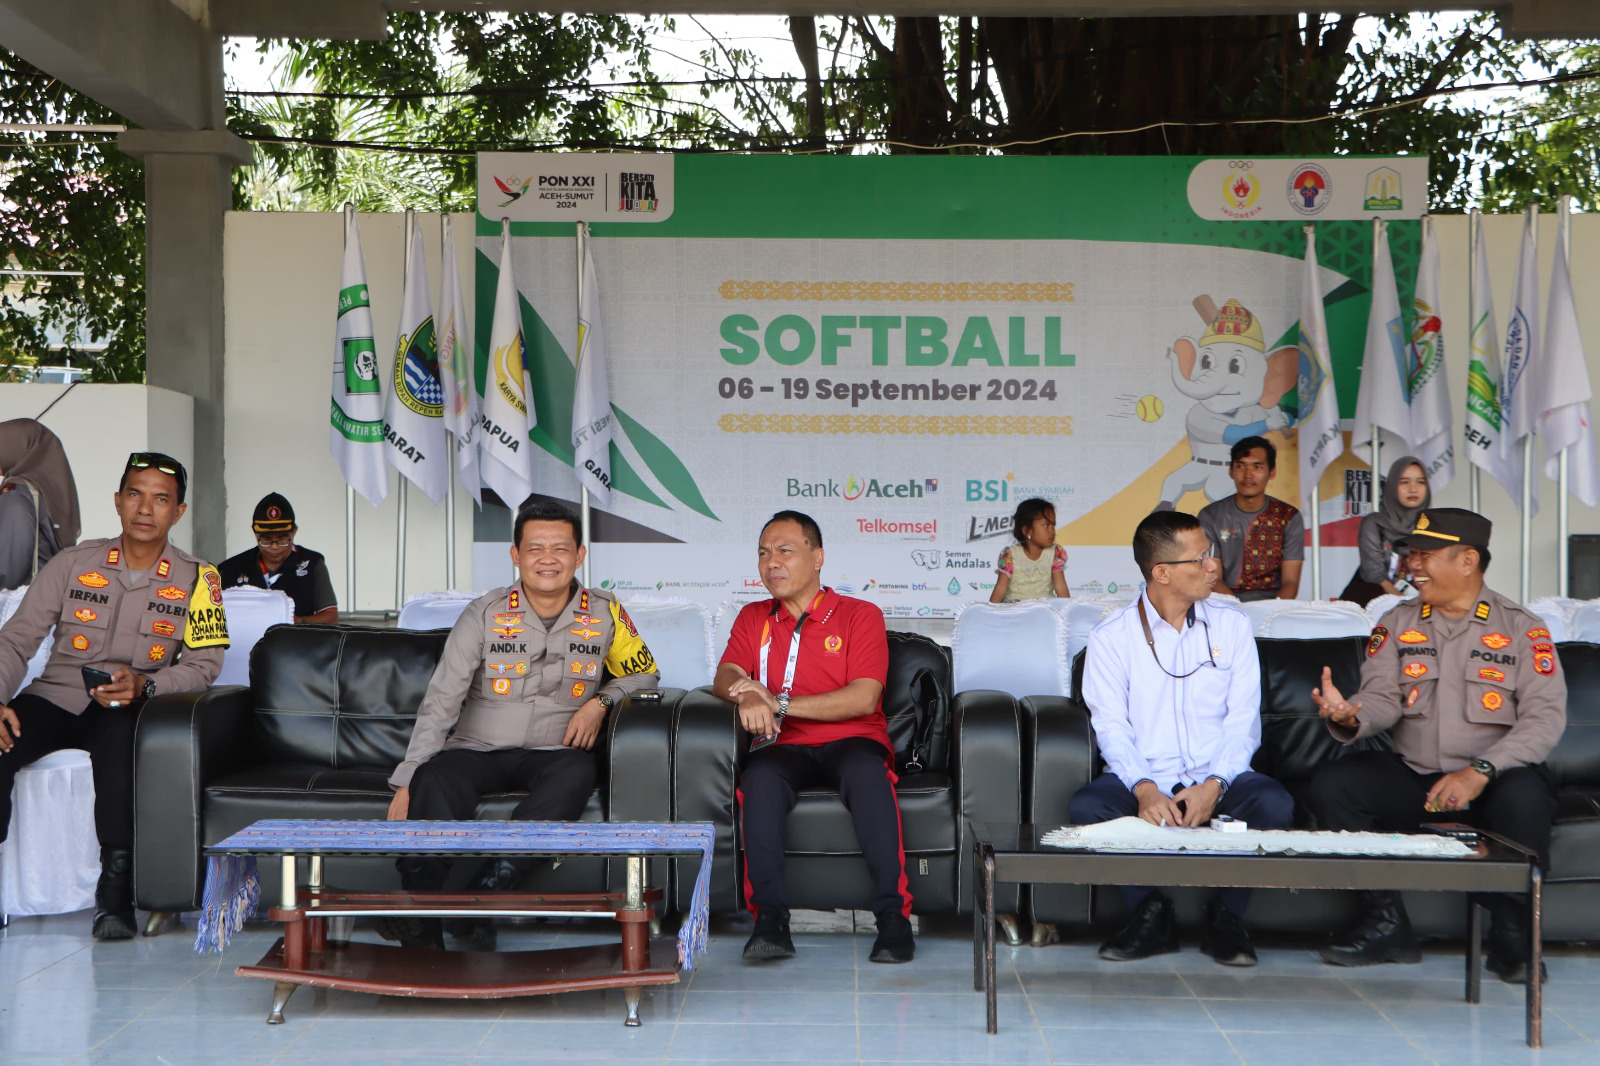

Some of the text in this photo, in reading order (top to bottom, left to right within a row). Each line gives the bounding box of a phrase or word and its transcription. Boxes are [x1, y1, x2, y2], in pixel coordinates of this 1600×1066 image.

[538, 176, 595, 187] PON XXI
[620, 172, 655, 182] BERSATU
[620, 181, 656, 201] KITA
[556, 201, 577, 209] 2024
[1220, 206, 1263, 219] INDONESIA
[719, 314, 1077, 367] SOFTBALL
[500, 381, 517, 404] KARYA
[718, 377, 754, 400] 06
[781, 378, 810, 400] 19
[815, 378, 982, 408] September
[987, 379, 1058, 401] 2024
[383, 423, 426, 464] BARAT
[787, 478, 923, 498] Bank Aceh
[966, 480, 1075, 502] BSI BANK SYARIAH
[856, 518, 937, 534] Telkomsel
[945, 559, 991, 569] Andalas
[69, 589, 109, 605] IRFAN
[147, 602, 187, 617] POLRI
[191, 623, 214, 636] JOHAN
[569, 643, 601, 655] POLRI
[1470, 650, 1516, 666] POLRI
